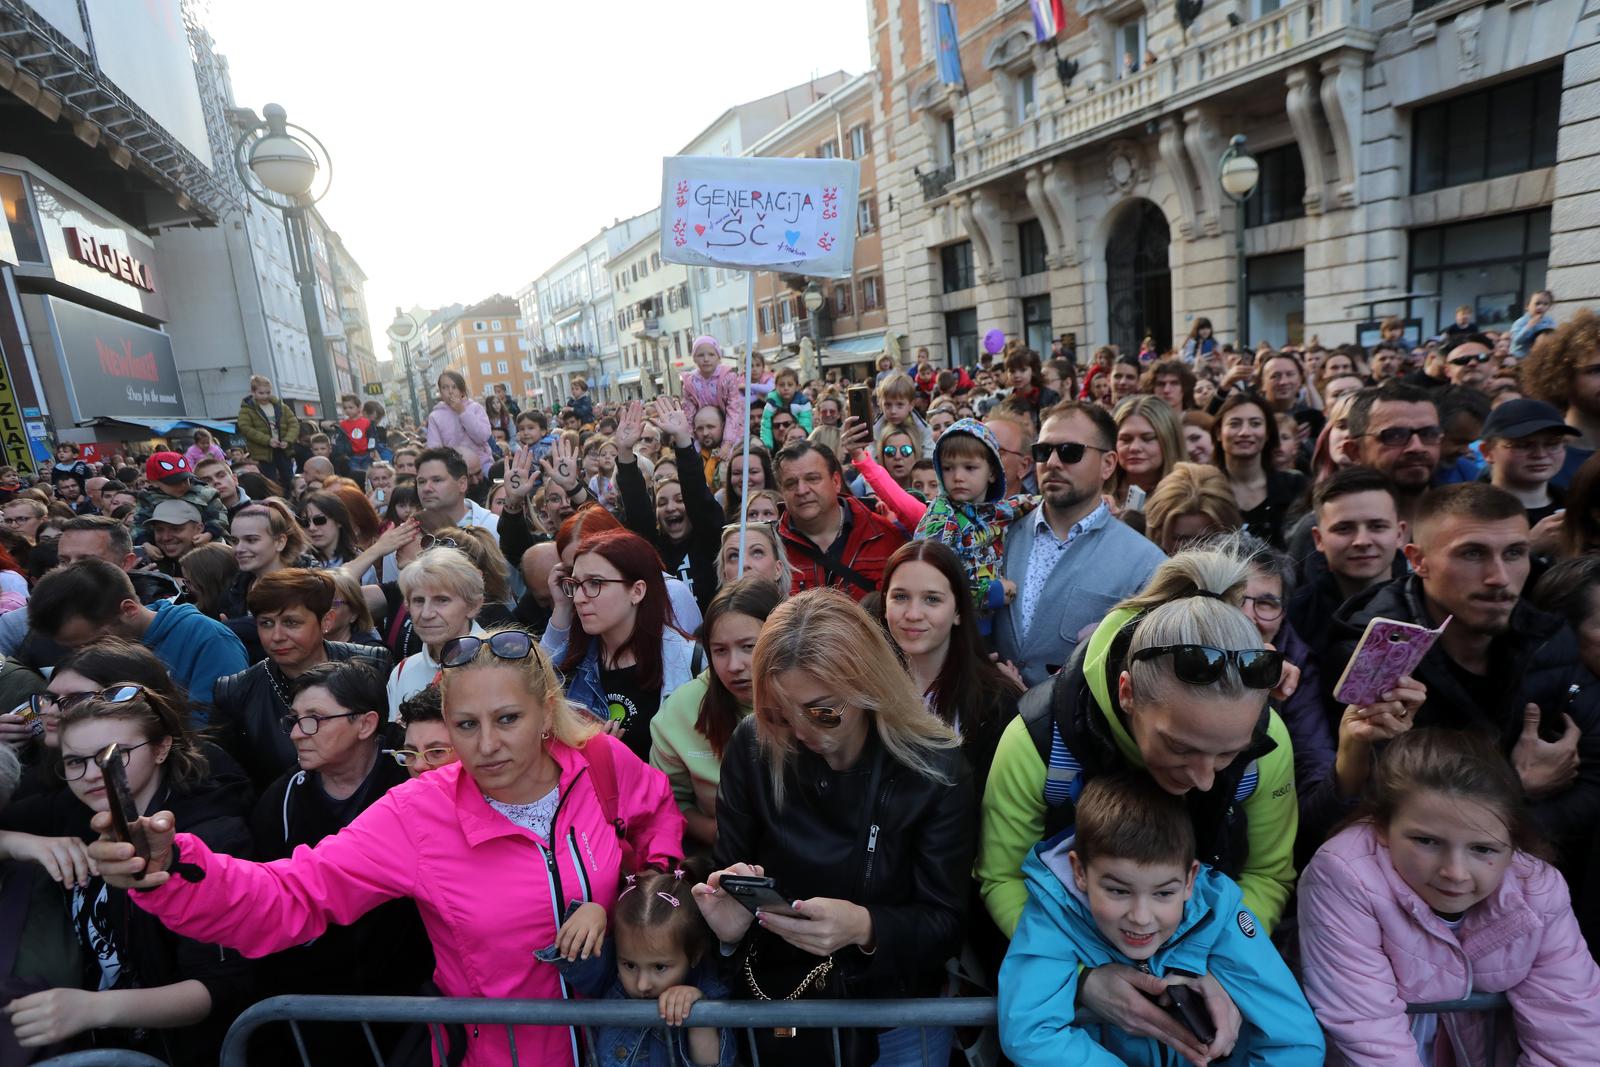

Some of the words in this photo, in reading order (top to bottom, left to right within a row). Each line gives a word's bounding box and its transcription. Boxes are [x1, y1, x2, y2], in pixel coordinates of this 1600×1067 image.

[706, 208, 769, 248] ŠČ
[74, 227, 157, 293] RIJEKA
[0, 402, 33, 474] ZLATA
[510, 471, 520, 489] Š
[558, 459, 570, 478] Č
[607, 693, 625, 703] MORE
[623, 698, 638, 717] SPACE
